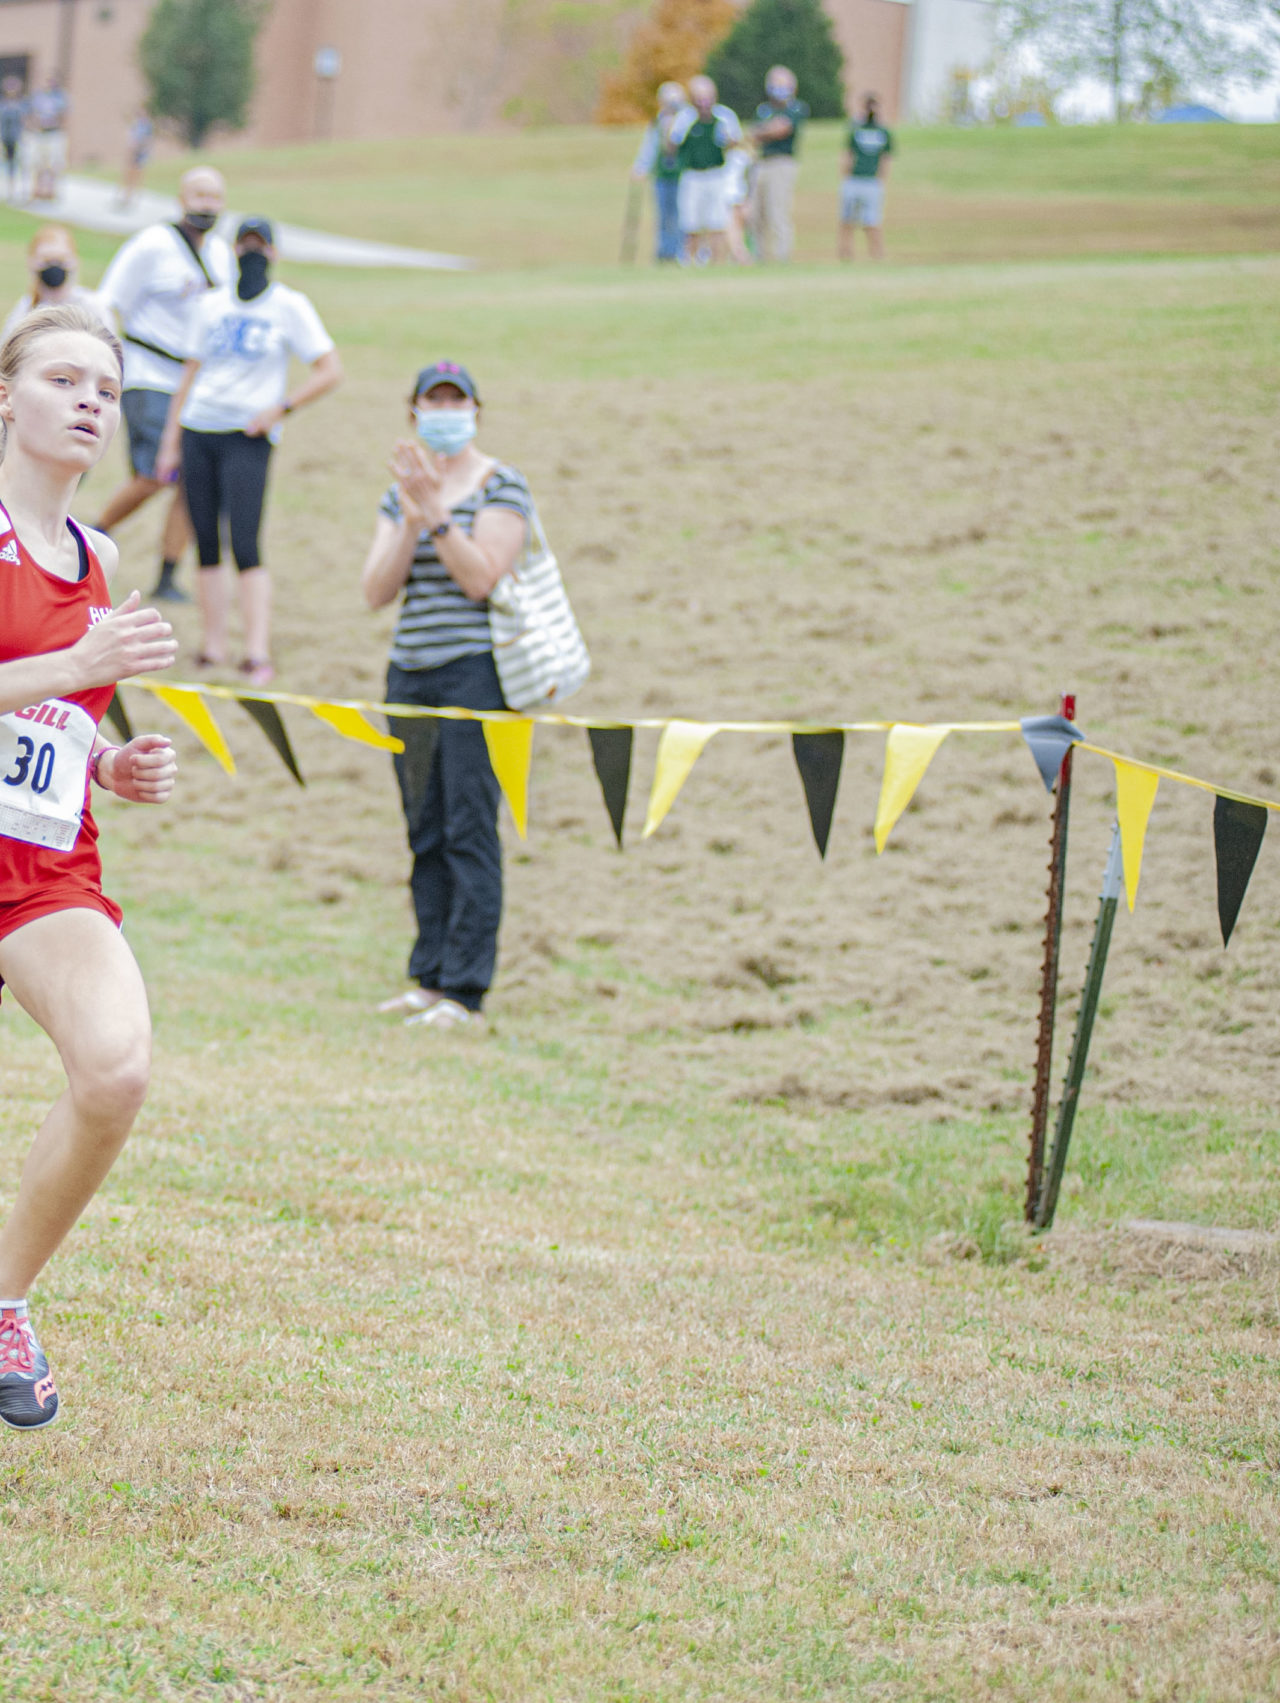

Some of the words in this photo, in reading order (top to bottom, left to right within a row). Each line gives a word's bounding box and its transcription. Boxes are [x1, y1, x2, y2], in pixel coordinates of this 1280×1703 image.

[88, 606, 113, 626] HH
[14, 704, 71, 731] GILL
[2, 735, 56, 795] 30
